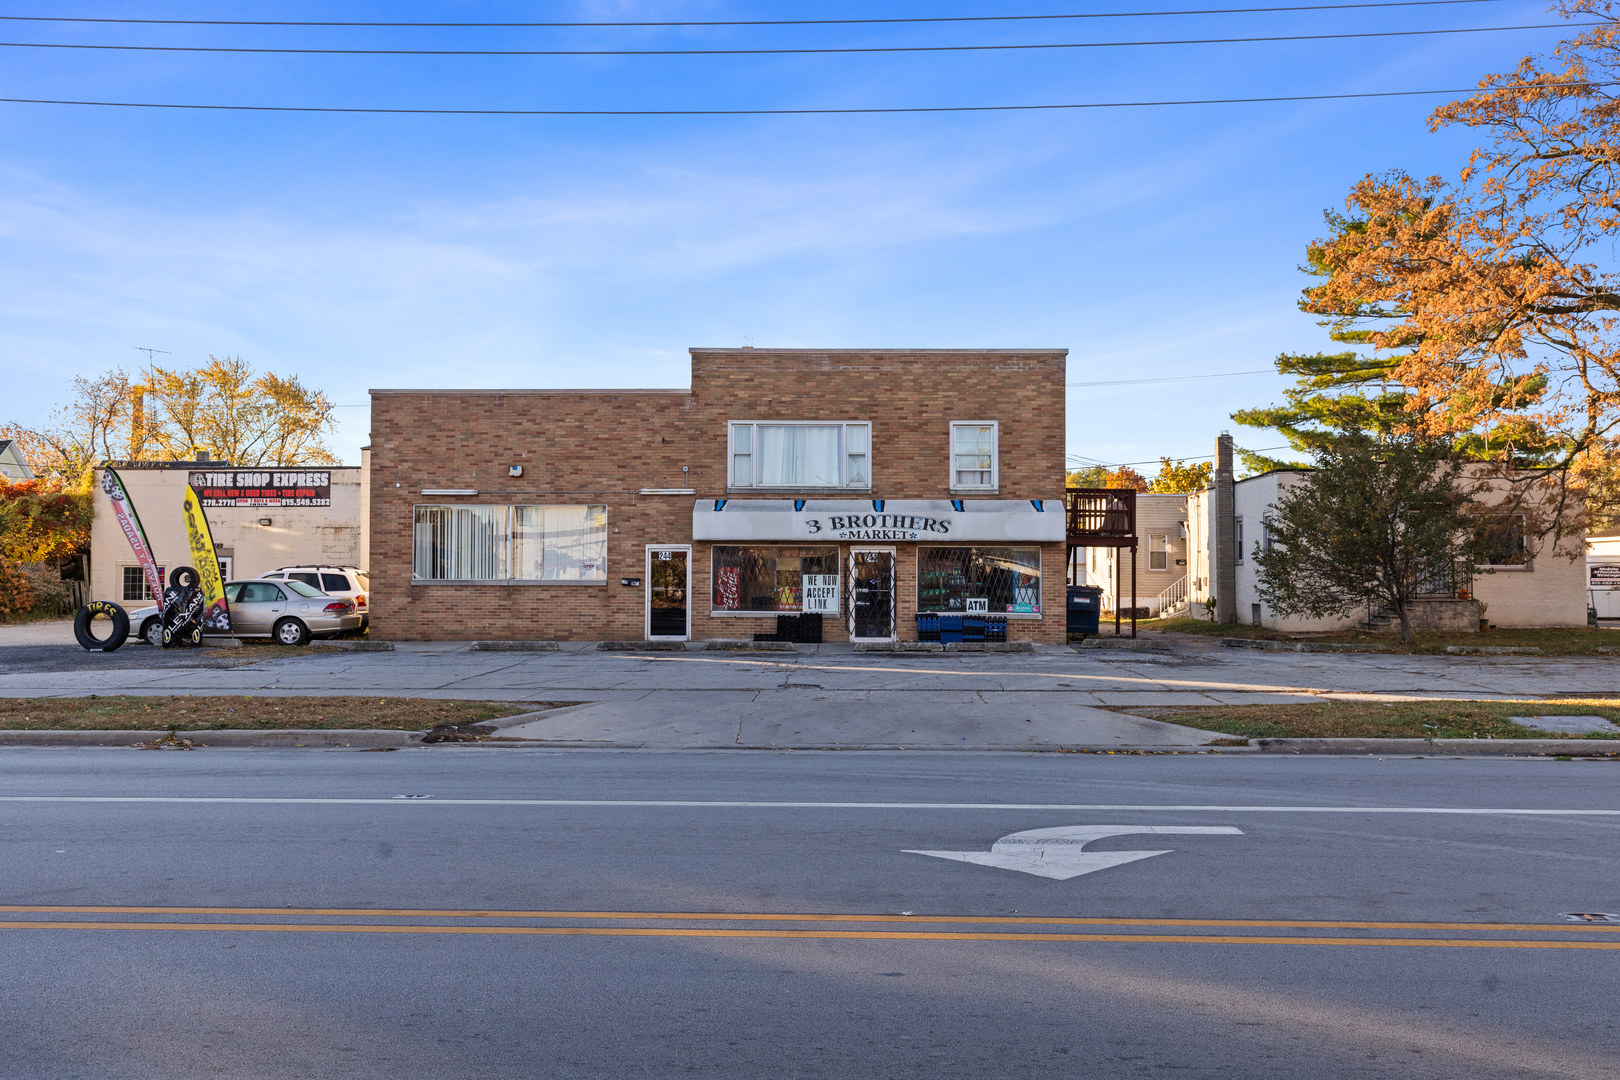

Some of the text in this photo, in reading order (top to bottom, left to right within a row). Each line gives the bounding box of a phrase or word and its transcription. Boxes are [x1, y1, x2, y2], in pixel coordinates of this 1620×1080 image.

[205, 473, 329, 487] TIRE SHOP EXPRESS
[261, 489, 277, 497] TIRES
[282, 489, 295, 497] TIRE
[806, 514, 952, 535] 3 BROTHERS
[848, 530, 909, 540] MARKET
[659, 551, 672, 560] 244
[807, 576, 838, 586] WE NOW
[806, 587, 836, 599] ACCEPT
[87, 601, 117, 617] TIRES
[807, 598, 828, 610] LINK
[967, 600, 987, 611] ATM
